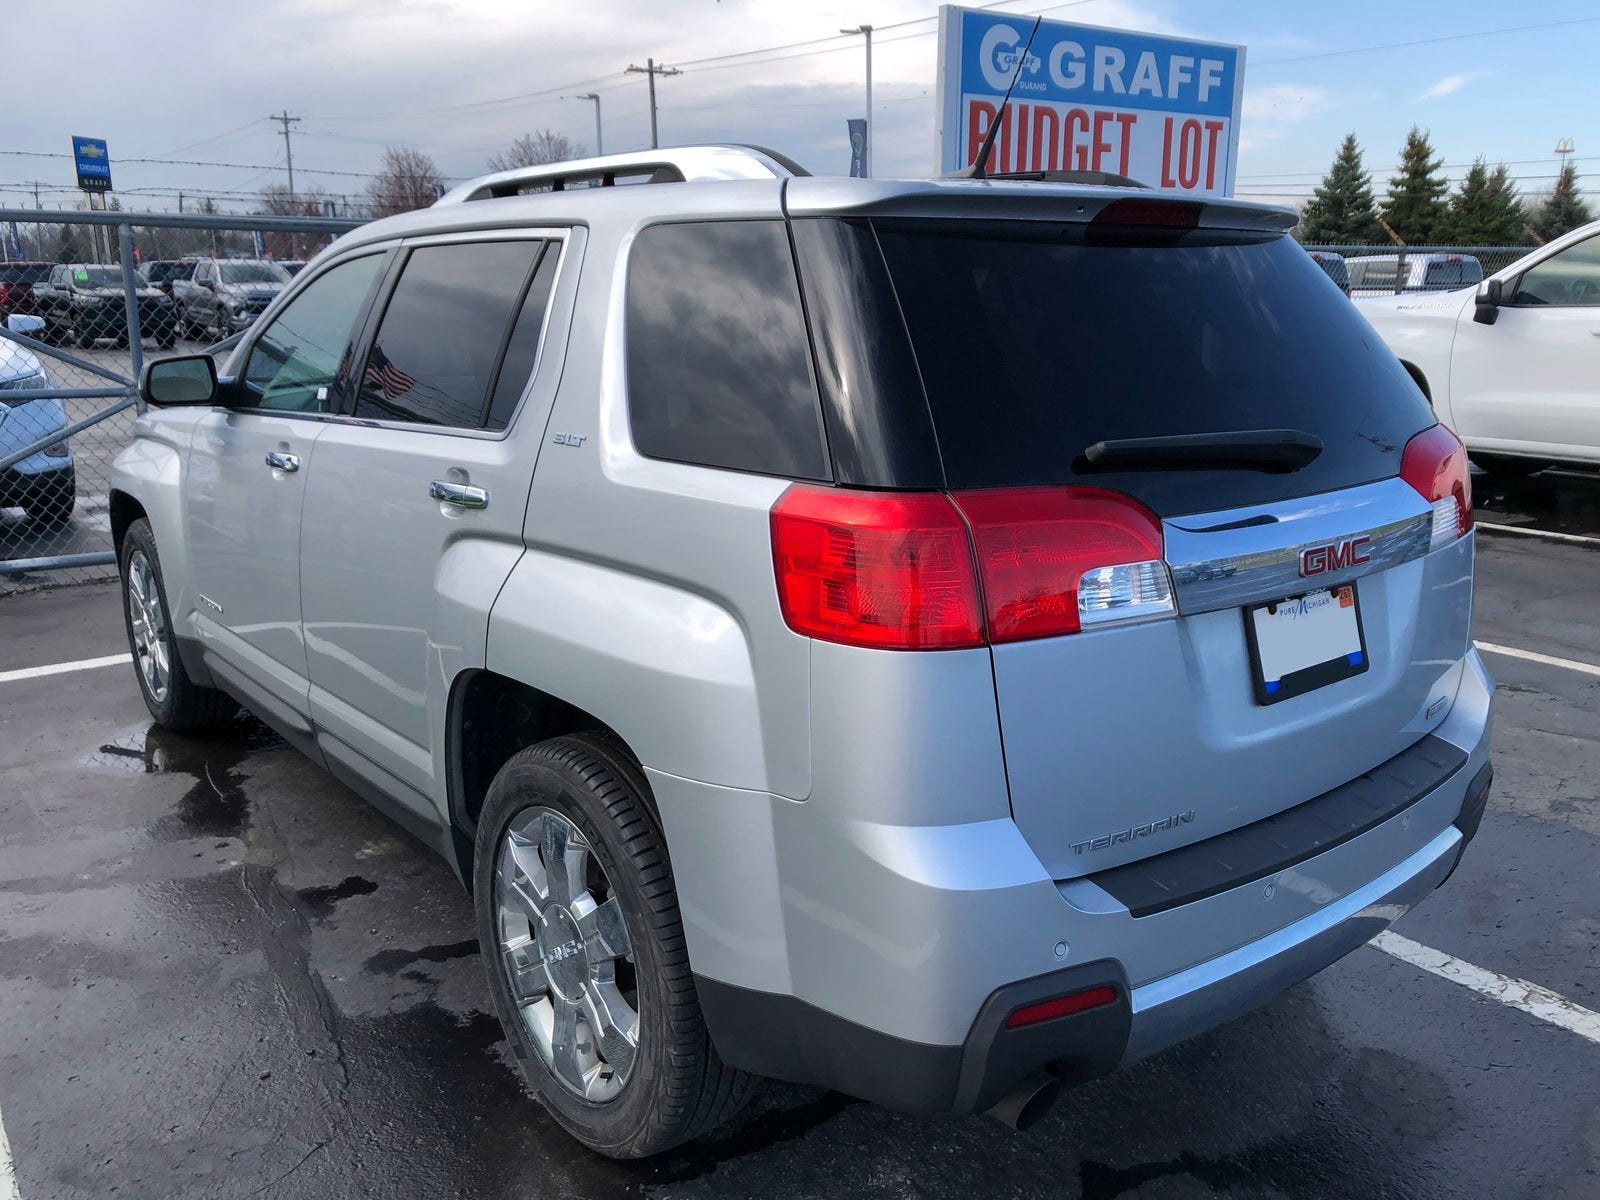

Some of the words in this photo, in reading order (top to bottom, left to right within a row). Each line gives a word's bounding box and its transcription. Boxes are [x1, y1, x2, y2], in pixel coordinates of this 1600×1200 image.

[1019, 80, 1048, 92] DURAND
[1049, 40, 1225, 102] GRAFF
[968, 99, 1137, 177] BUDGET
[1161, 117, 1223, 190] LOT
[552, 432, 587, 448] SLT
[1299, 534, 1372, 577] GMC
[1279, 606, 1296, 617] PURE
[1294, 598, 1330, 620] MICHIGAN
[1068, 809, 1196, 856] TERRAIN
